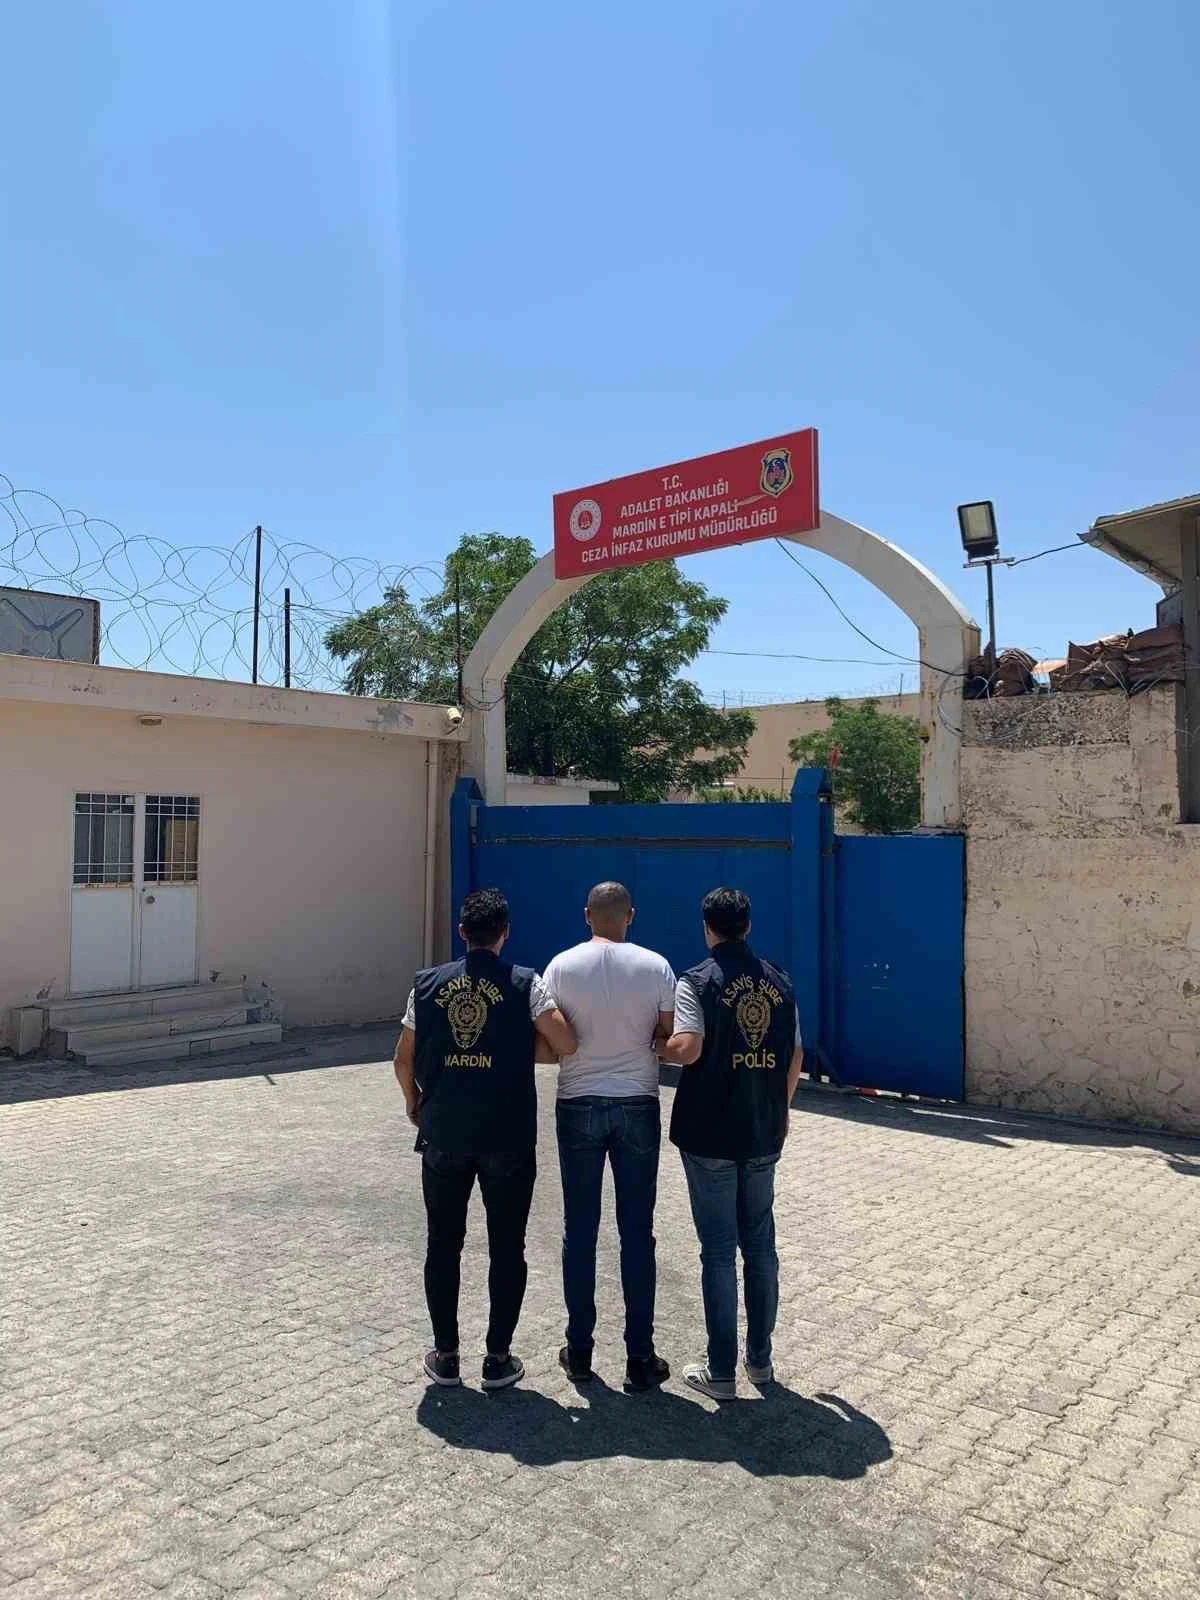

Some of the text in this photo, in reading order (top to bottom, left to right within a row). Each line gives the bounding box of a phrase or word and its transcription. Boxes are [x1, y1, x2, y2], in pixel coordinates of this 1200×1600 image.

[621, 479, 729, 518] ADALET BAKANLIĞI
[661, 475, 683, 491] T.C.
[582, 507, 777, 563] CEZA İNFAZ KURUMU MÜDÜRLÜĞÜ
[612, 517, 657, 539] MARDİN
[659, 515, 666, 529] E
[669, 506, 691, 526] TİPİ
[732, 1048, 776, 1070] POLİS
